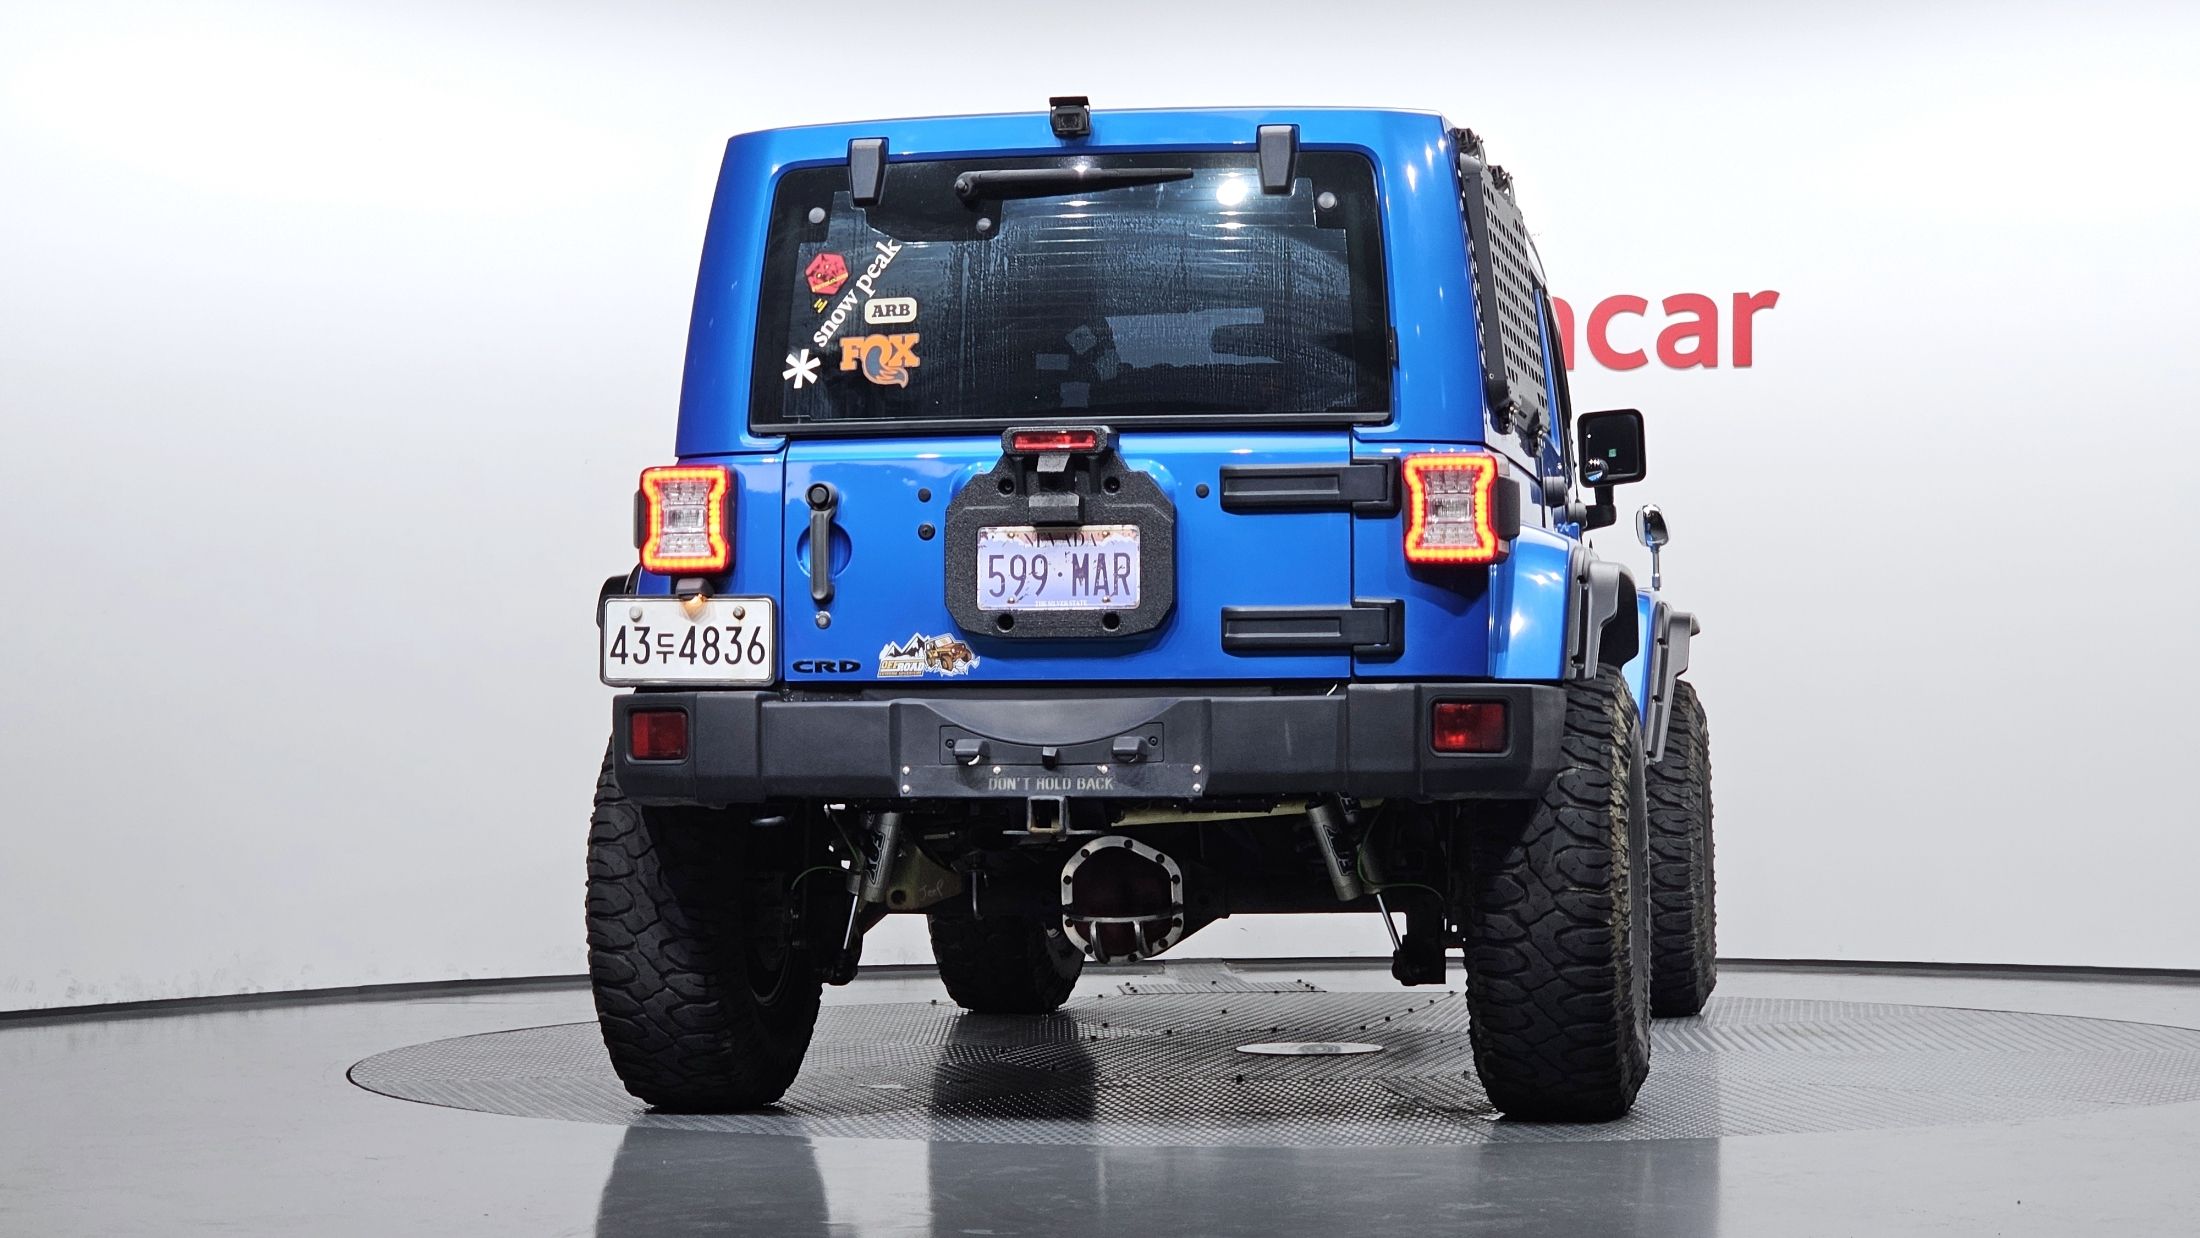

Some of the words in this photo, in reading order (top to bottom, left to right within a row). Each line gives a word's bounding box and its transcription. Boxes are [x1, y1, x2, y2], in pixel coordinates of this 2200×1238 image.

[813, 289, 859, 348] snow
[856, 238, 902, 298] peak
[871, 303, 911, 318] ARB
[840, 333, 920, 388] FOX
[610, 625, 766, 665] 43두4836
[792, 660, 861, 673] CRD
[988, 777, 1030, 791] DON'T
[1036, 777, 1072, 791] HOLD
[1077, 777, 1114, 791] BACK
